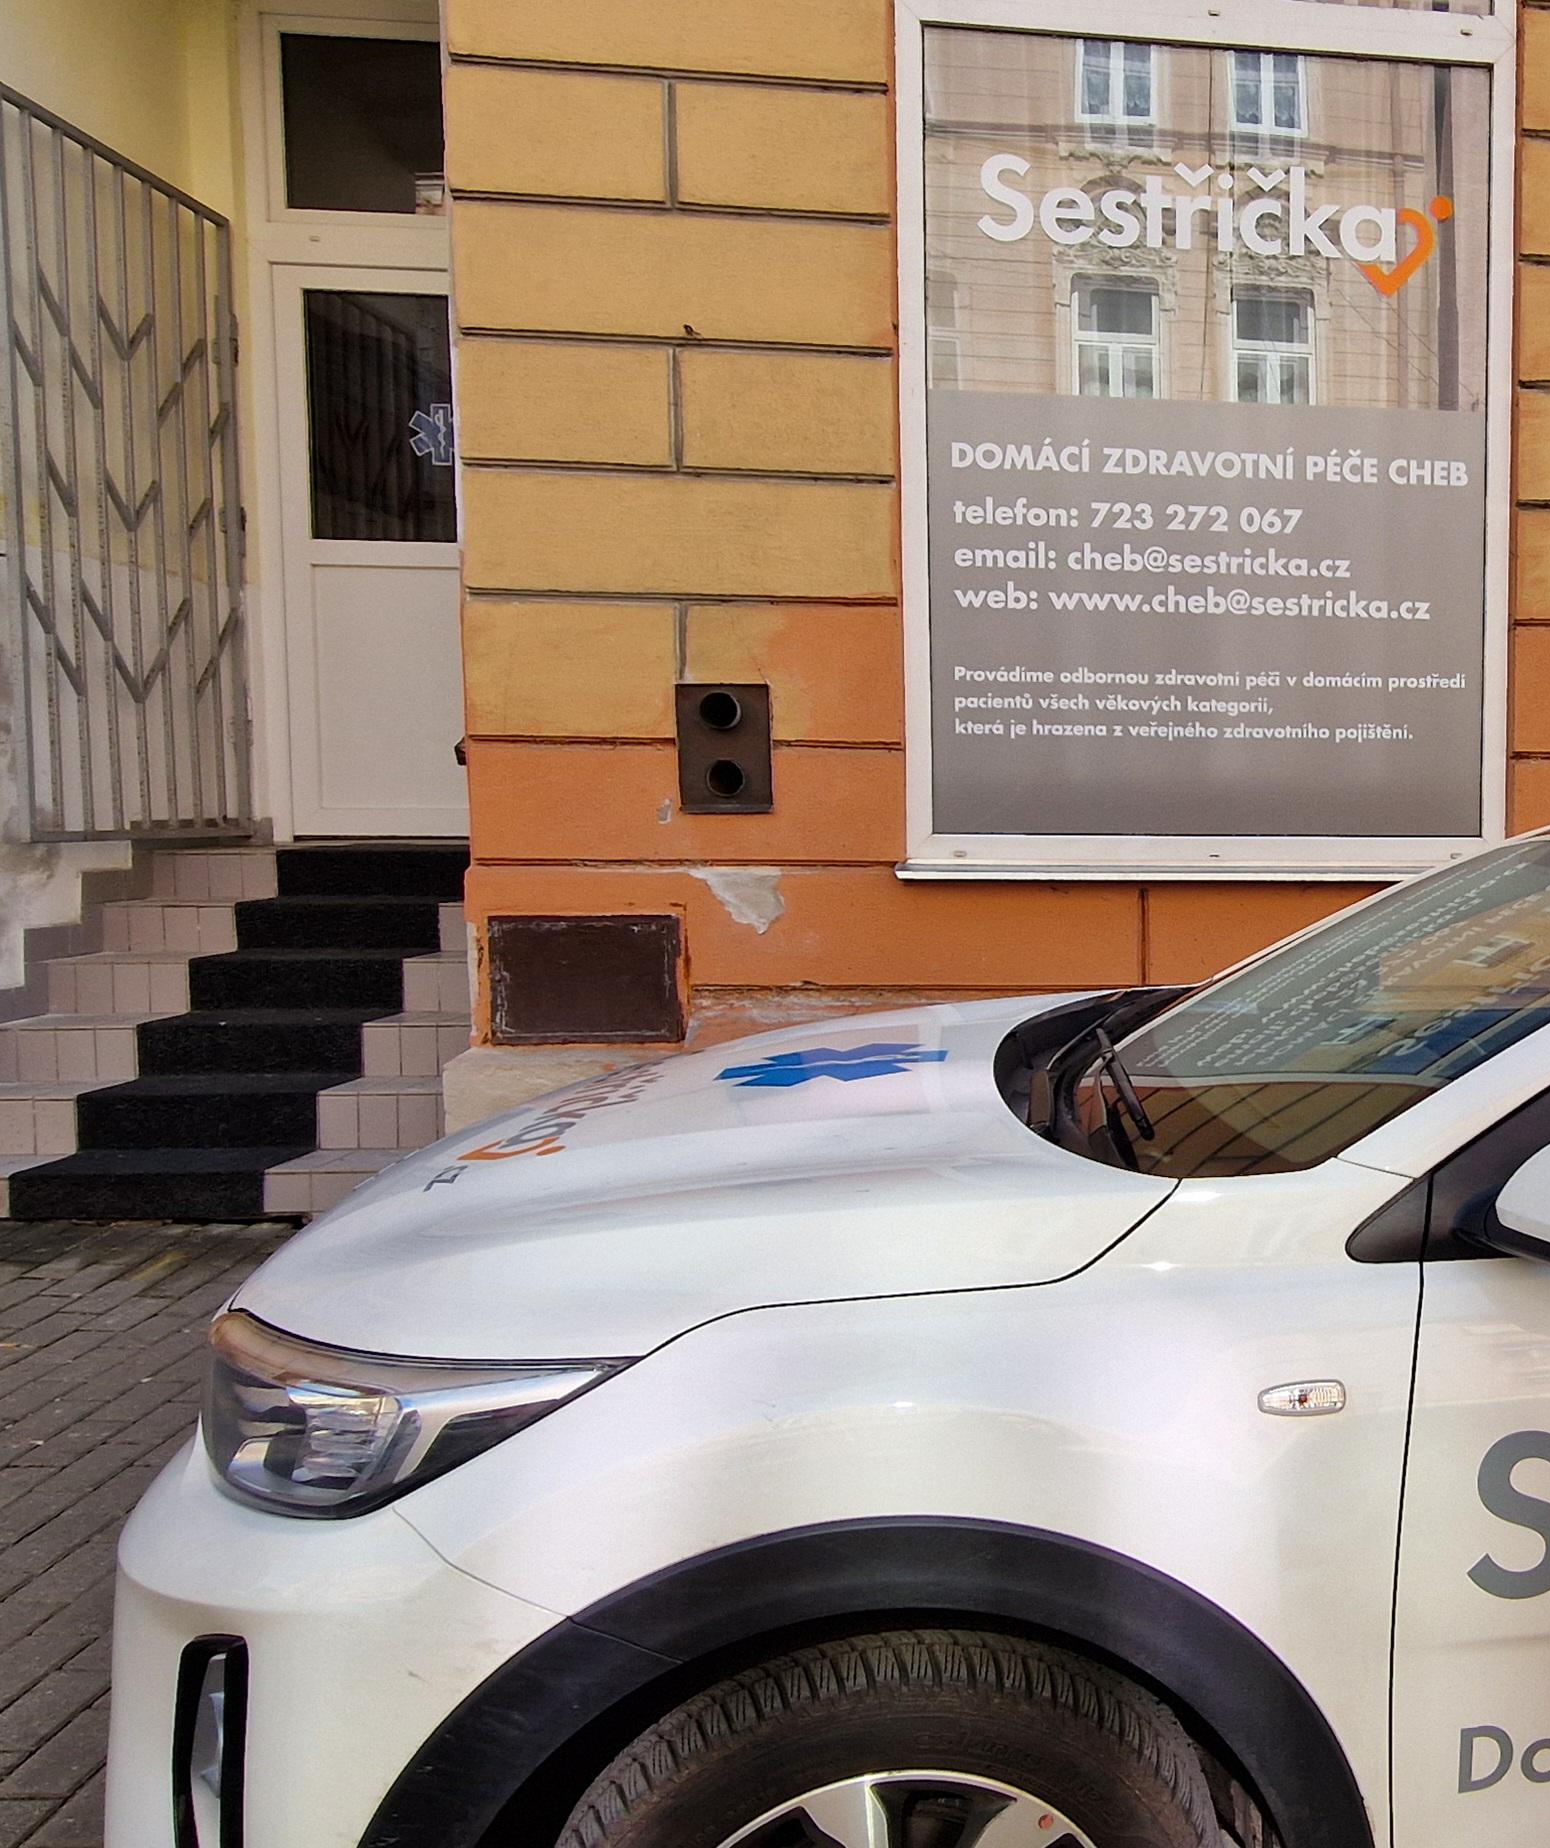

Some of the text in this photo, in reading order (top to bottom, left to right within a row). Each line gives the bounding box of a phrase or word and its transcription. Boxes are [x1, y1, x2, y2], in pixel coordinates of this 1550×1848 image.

[977, 154, 1397, 262] Sestřička
[951, 437, 1469, 485] DOMÁCÍ ZDRAVOTNÍ PÉČE CHEB
[953, 496, 1303, 535] telefon: 723 272 067
[954, 540, 1351, 578] email: cheb@sestricka.cz
[953, 580, 1431, 620] web: www.cheb@sestricka.cz
[954, 665, 1055, 683] Provádíme
[1059, 666, 1149, 685] odbornou
[1155, 668, 1240, 687] zdravotní
[1286, 676, 1297, 687] v
[1302, 671, 1383, 688] domácím
[1388, 672, 1466, 692] prostředí
[954, 692, 1033, 713] pacientů
[1038, 693, 1090, 710] všech
[1095, 694, 1182, 715] věkových
[955, 718, 1413, 743] která je hrazena z veřejného zdravotního pojištění.
